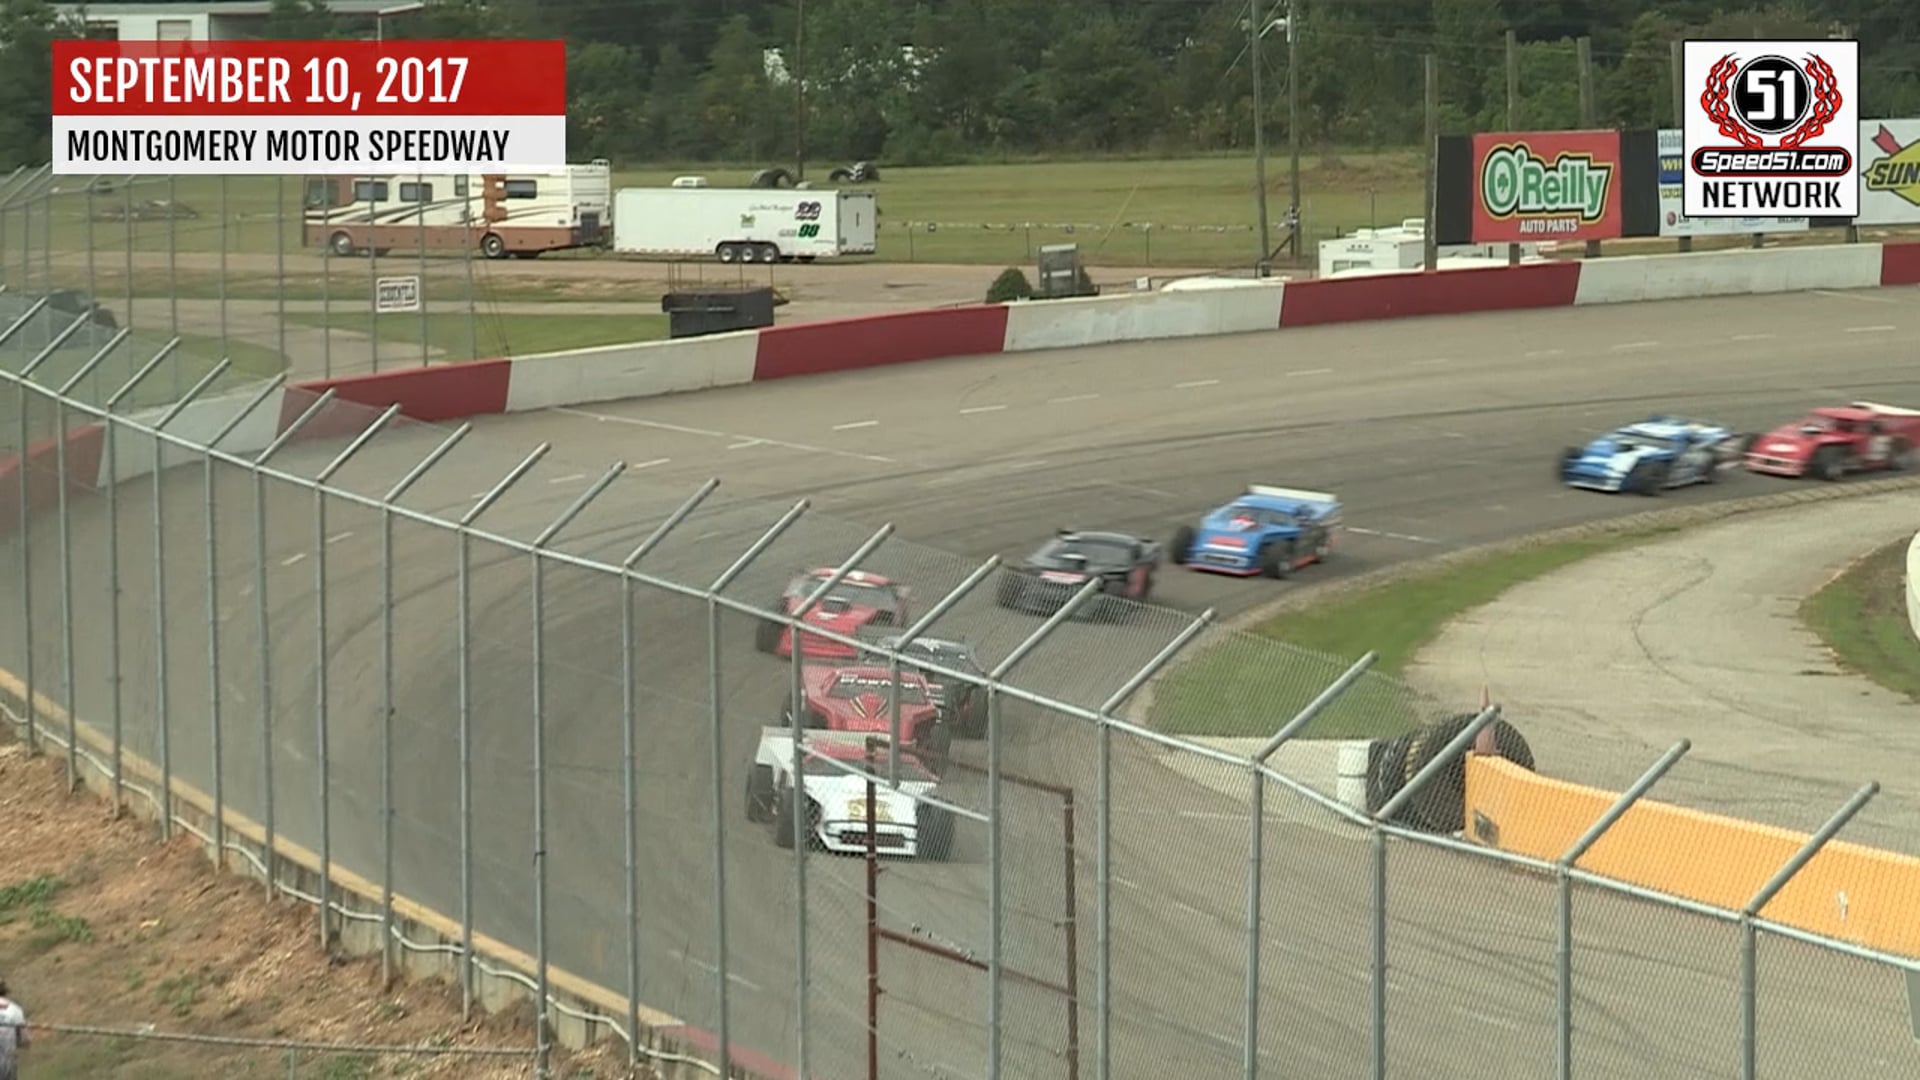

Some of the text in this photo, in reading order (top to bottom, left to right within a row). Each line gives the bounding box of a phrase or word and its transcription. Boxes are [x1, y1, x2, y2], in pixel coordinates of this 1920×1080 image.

[1485, 150, 1606, 215] O'Reilly
[1871, 162, 1920, 186] SUN
[1519, 218, 1578, 234] AUTO PARTS
